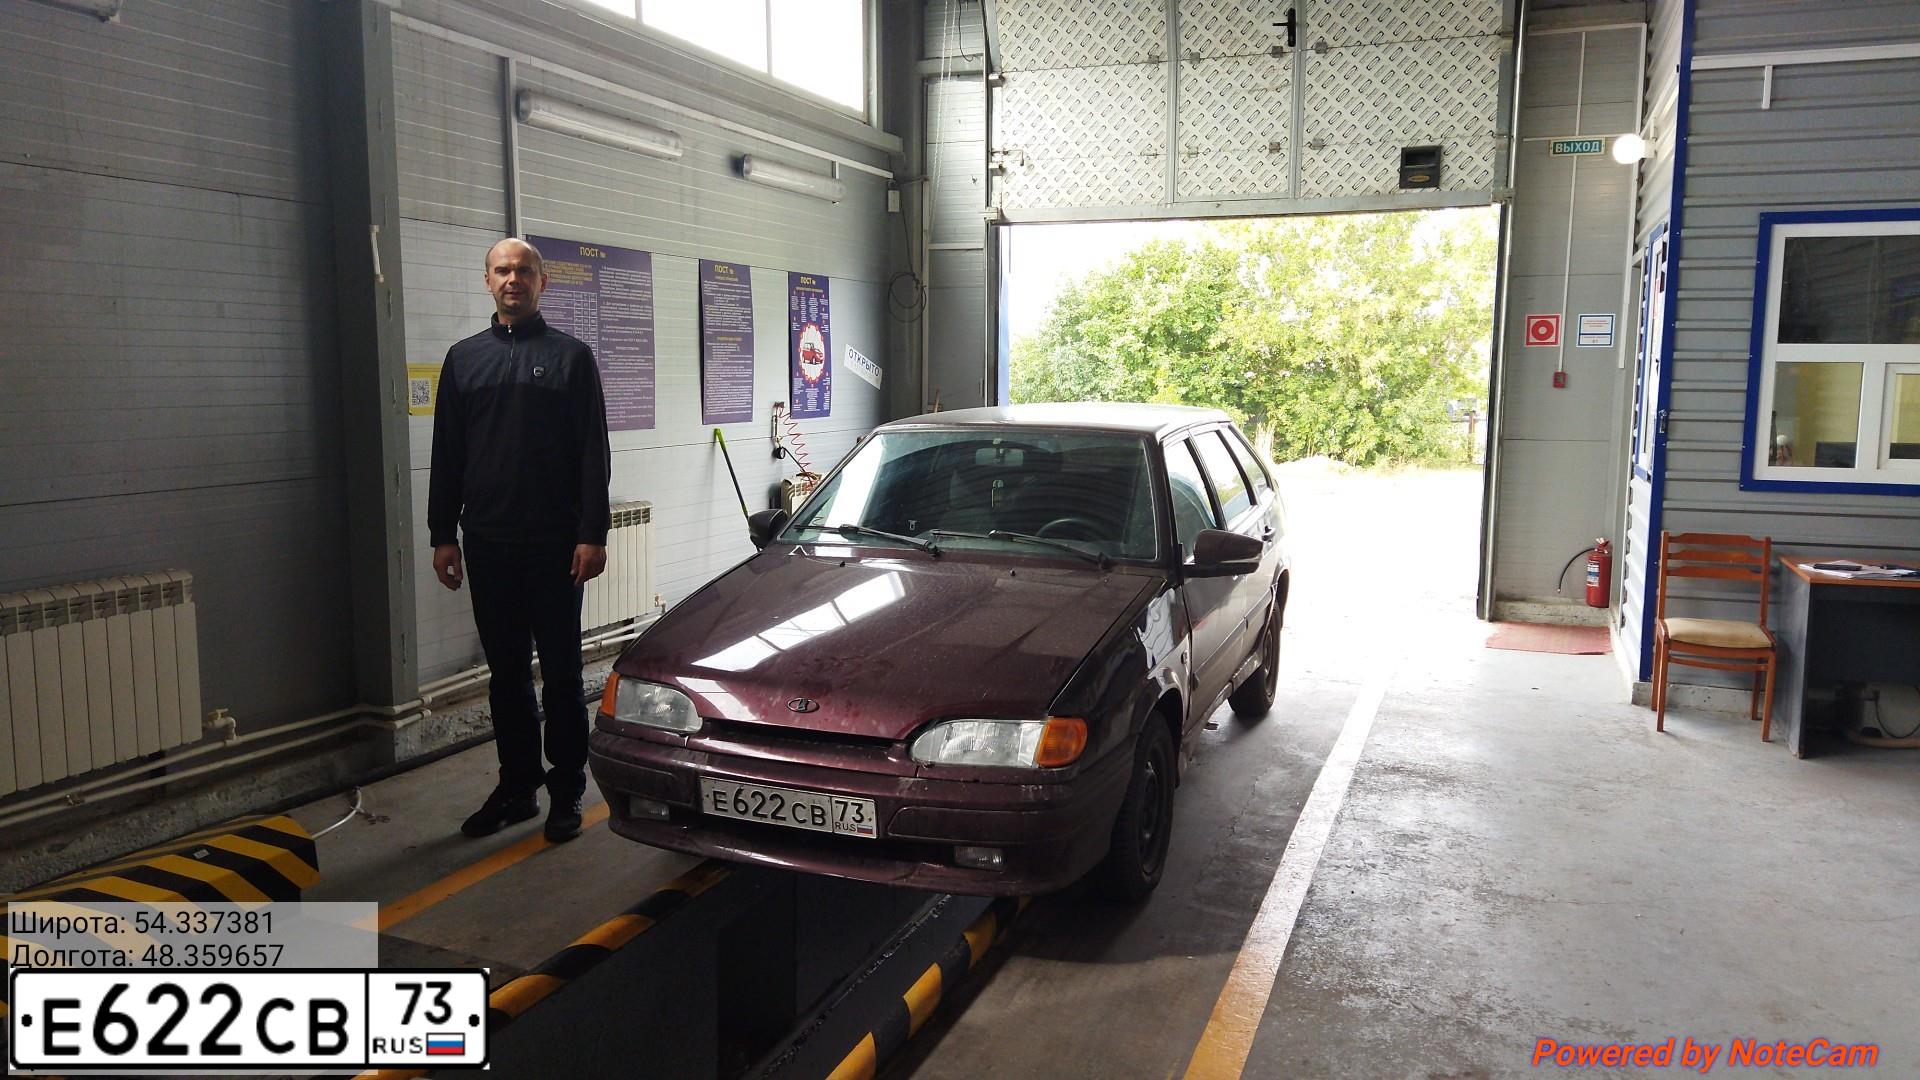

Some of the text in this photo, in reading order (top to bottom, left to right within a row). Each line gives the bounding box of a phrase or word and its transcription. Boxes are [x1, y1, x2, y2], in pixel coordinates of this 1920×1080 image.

[1555, 140, 1600, 154] ВЫХОД
[580, 246, 599, 258] ПОСТ
[848, 348, 880, 378] ОТКРЫТО
[834, 800, 864, 824] 73
[835, 822, 857, 832] RUS
